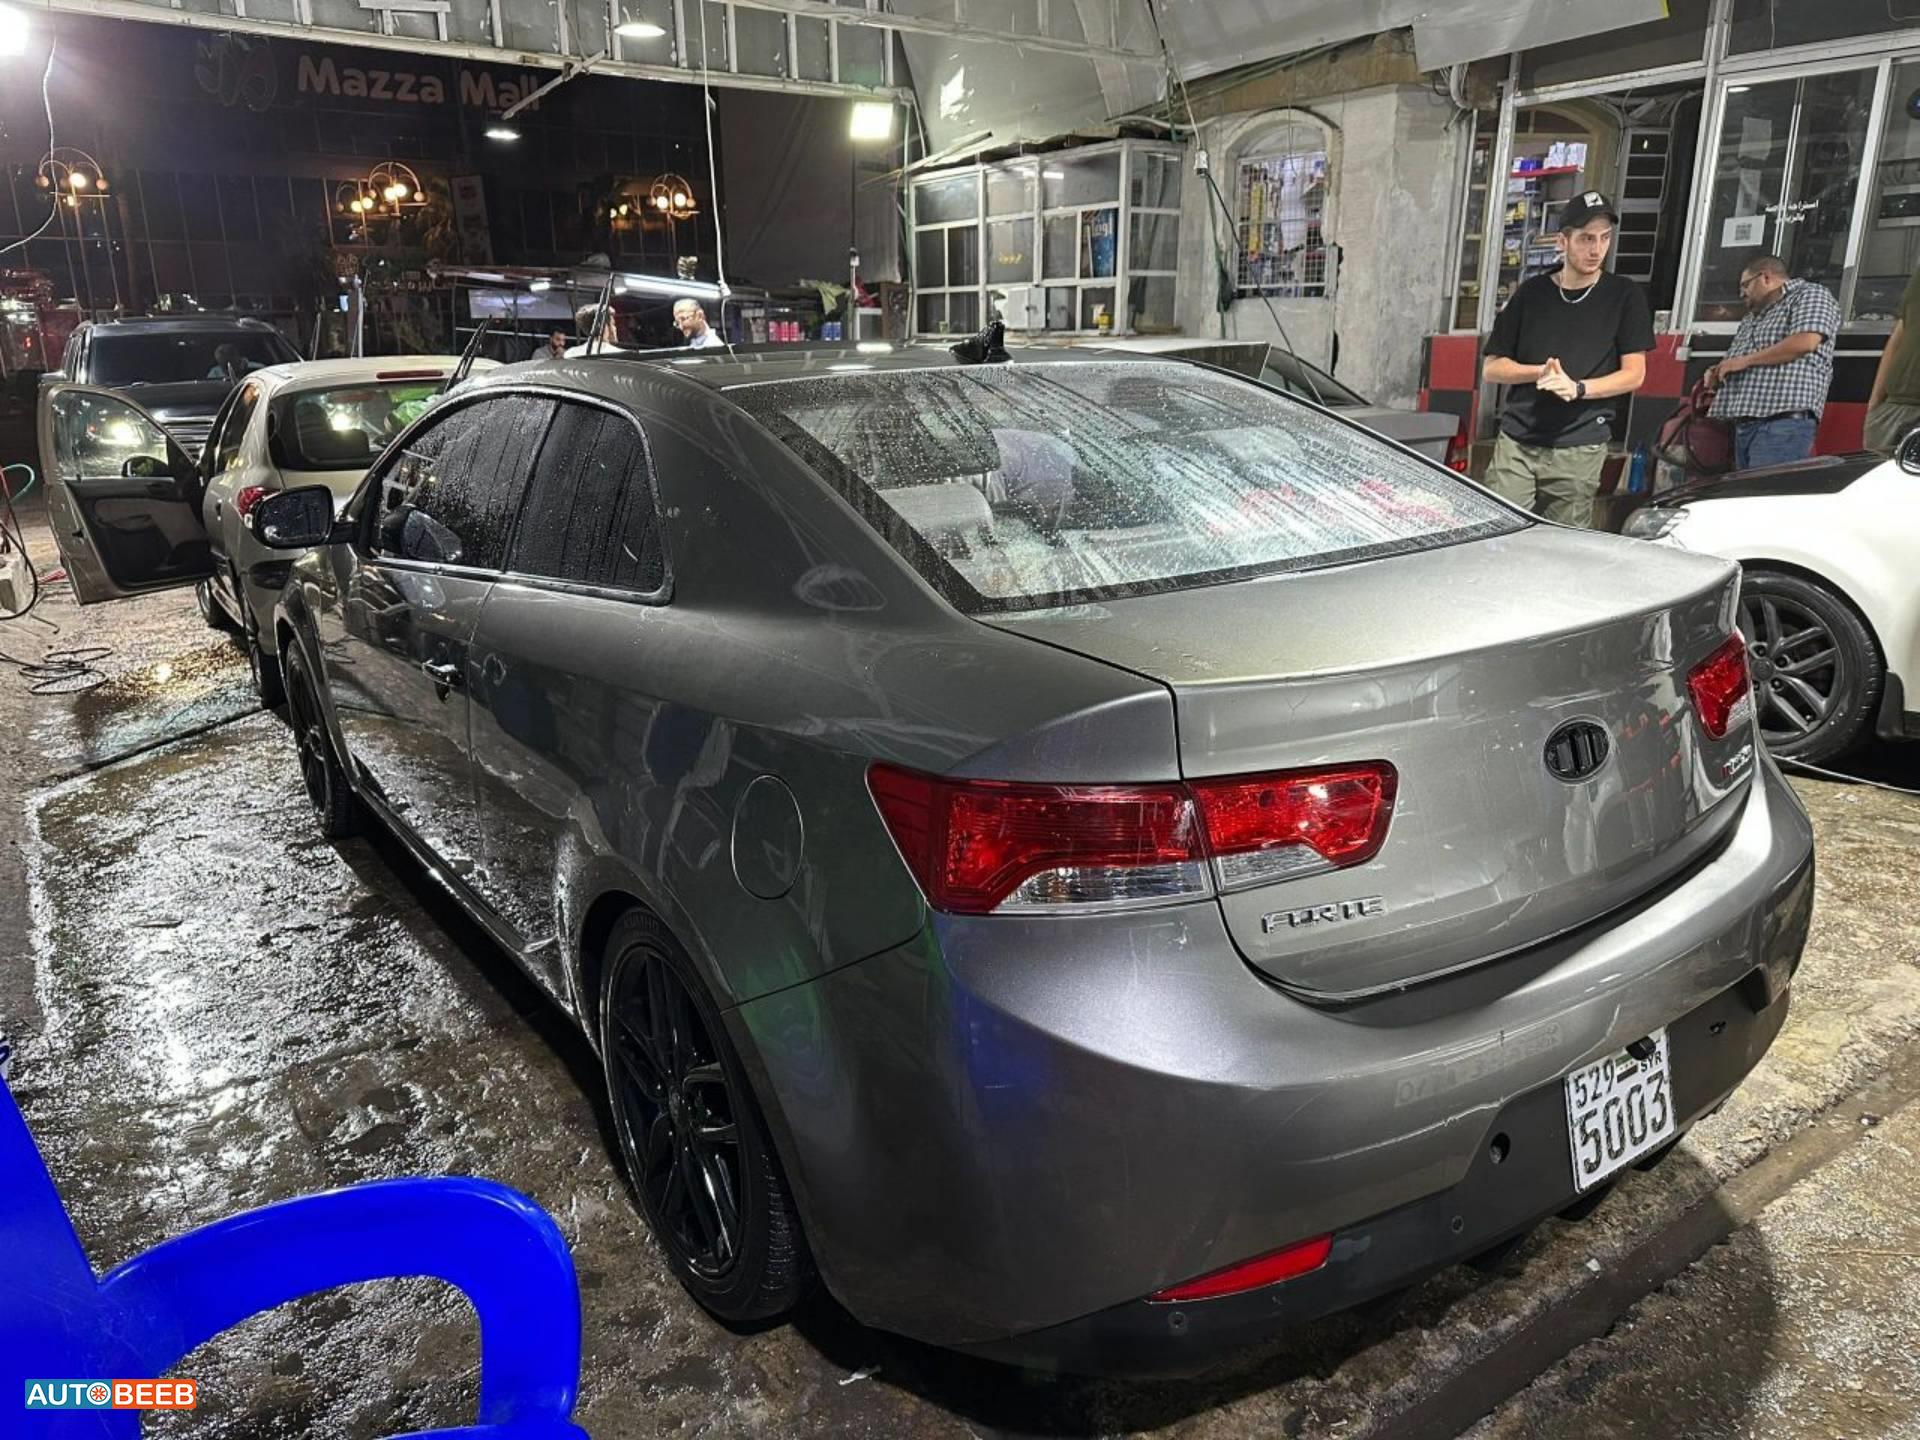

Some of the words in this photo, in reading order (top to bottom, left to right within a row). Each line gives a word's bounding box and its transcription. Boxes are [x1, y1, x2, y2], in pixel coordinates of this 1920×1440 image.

[298, 55, 445, 104] Mazza
[460, 70, 540, 111] Mall
[1261, 895, 1385, 934] FORTE
[1573, 1058, 1615, 1109] 529
[1639, 1050, 1662, 1073] SYR
[1578, 1070, 1667, 1175] 5003
